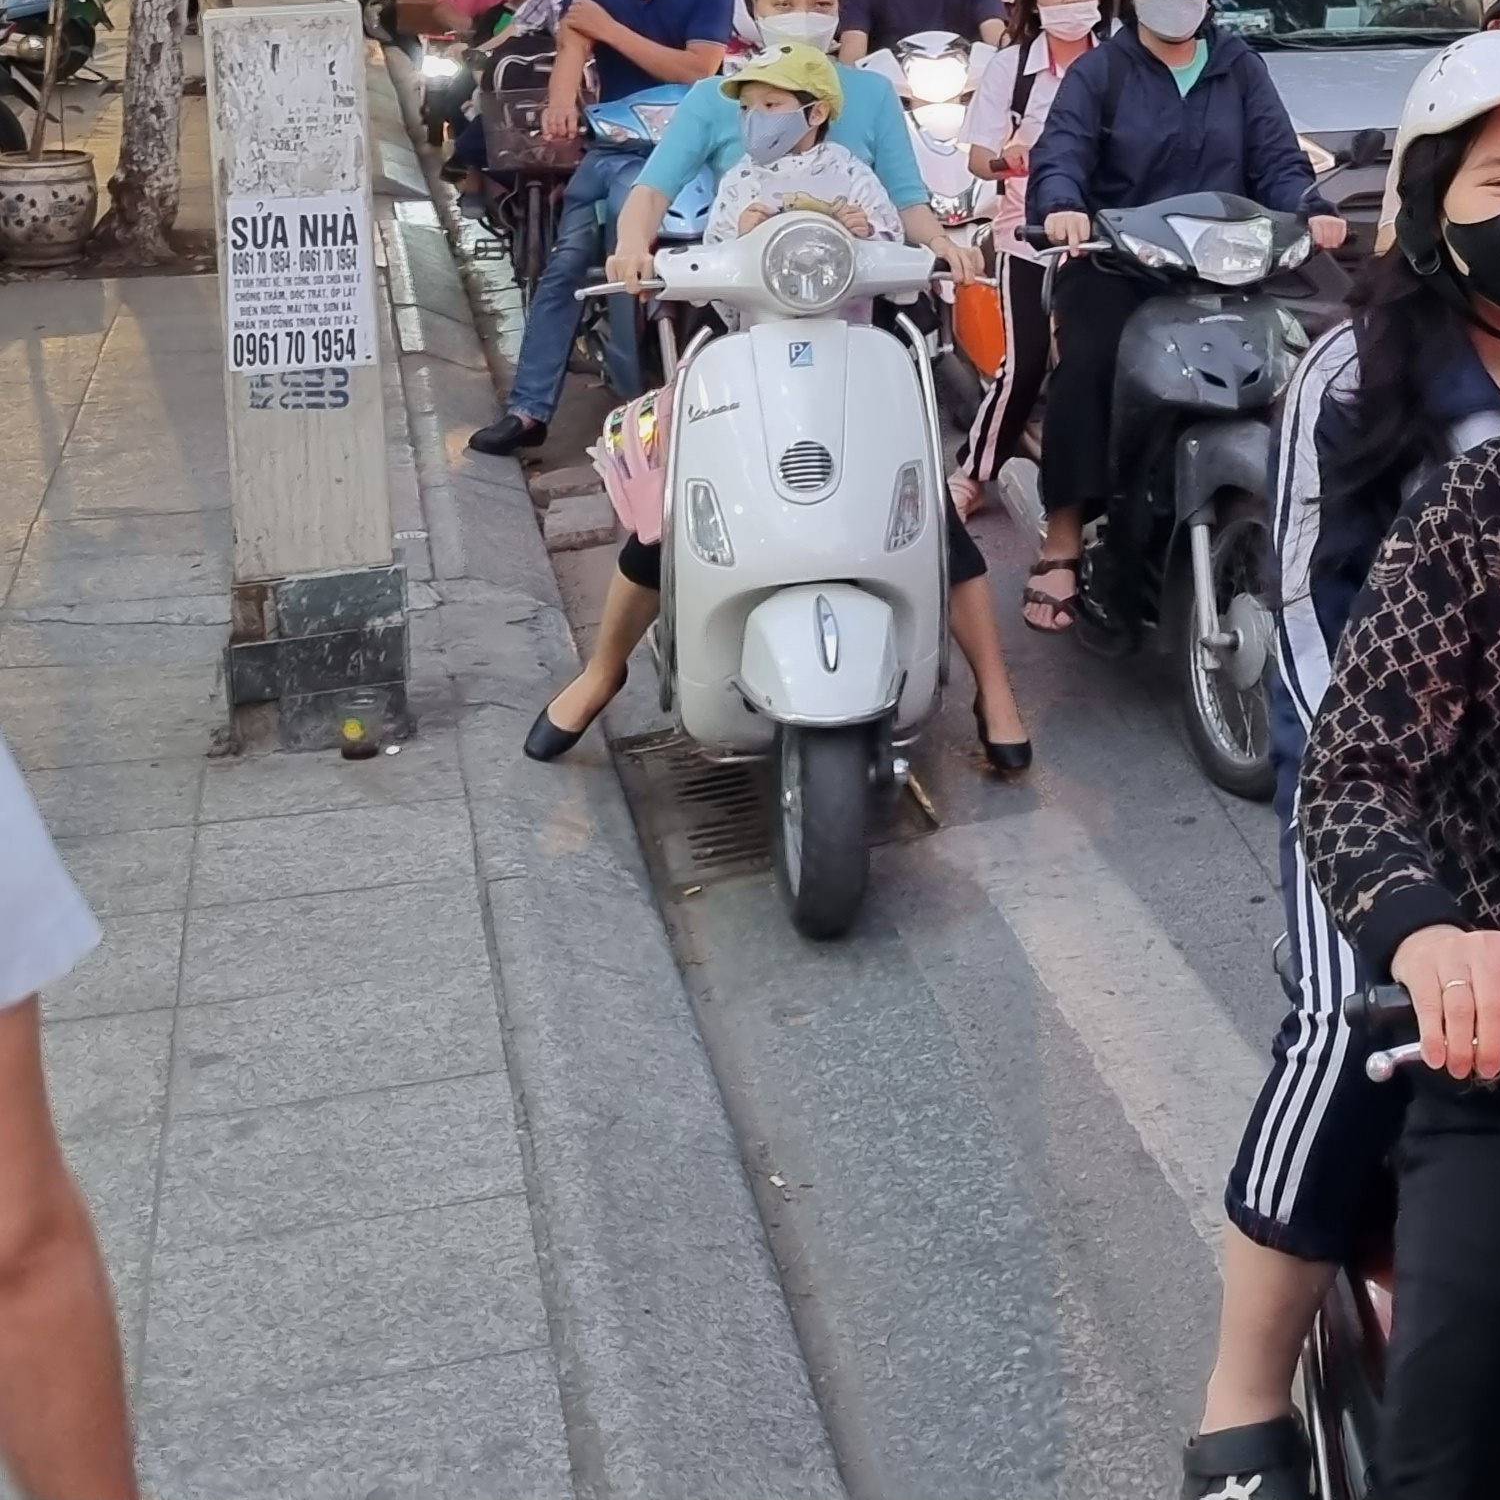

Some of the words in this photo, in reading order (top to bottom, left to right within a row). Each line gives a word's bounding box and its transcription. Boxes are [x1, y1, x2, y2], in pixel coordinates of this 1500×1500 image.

[231, 201, 289, 250] SỬA
[300, 205, 359, 248] NHÀ
[233, 251, 254, 275] 0961
[257, 250, 267, 274] 70
[270, 250, 290, 274] 1954
[299, 249, 321, 272] 0961
[323, 248, 333, 271] 70
[336, 247, 357, 271] 1954
[233, 332, 278, 367] 0961
[285, 330, 305, 364] 70
[312, 328, 356, 363] 1954
